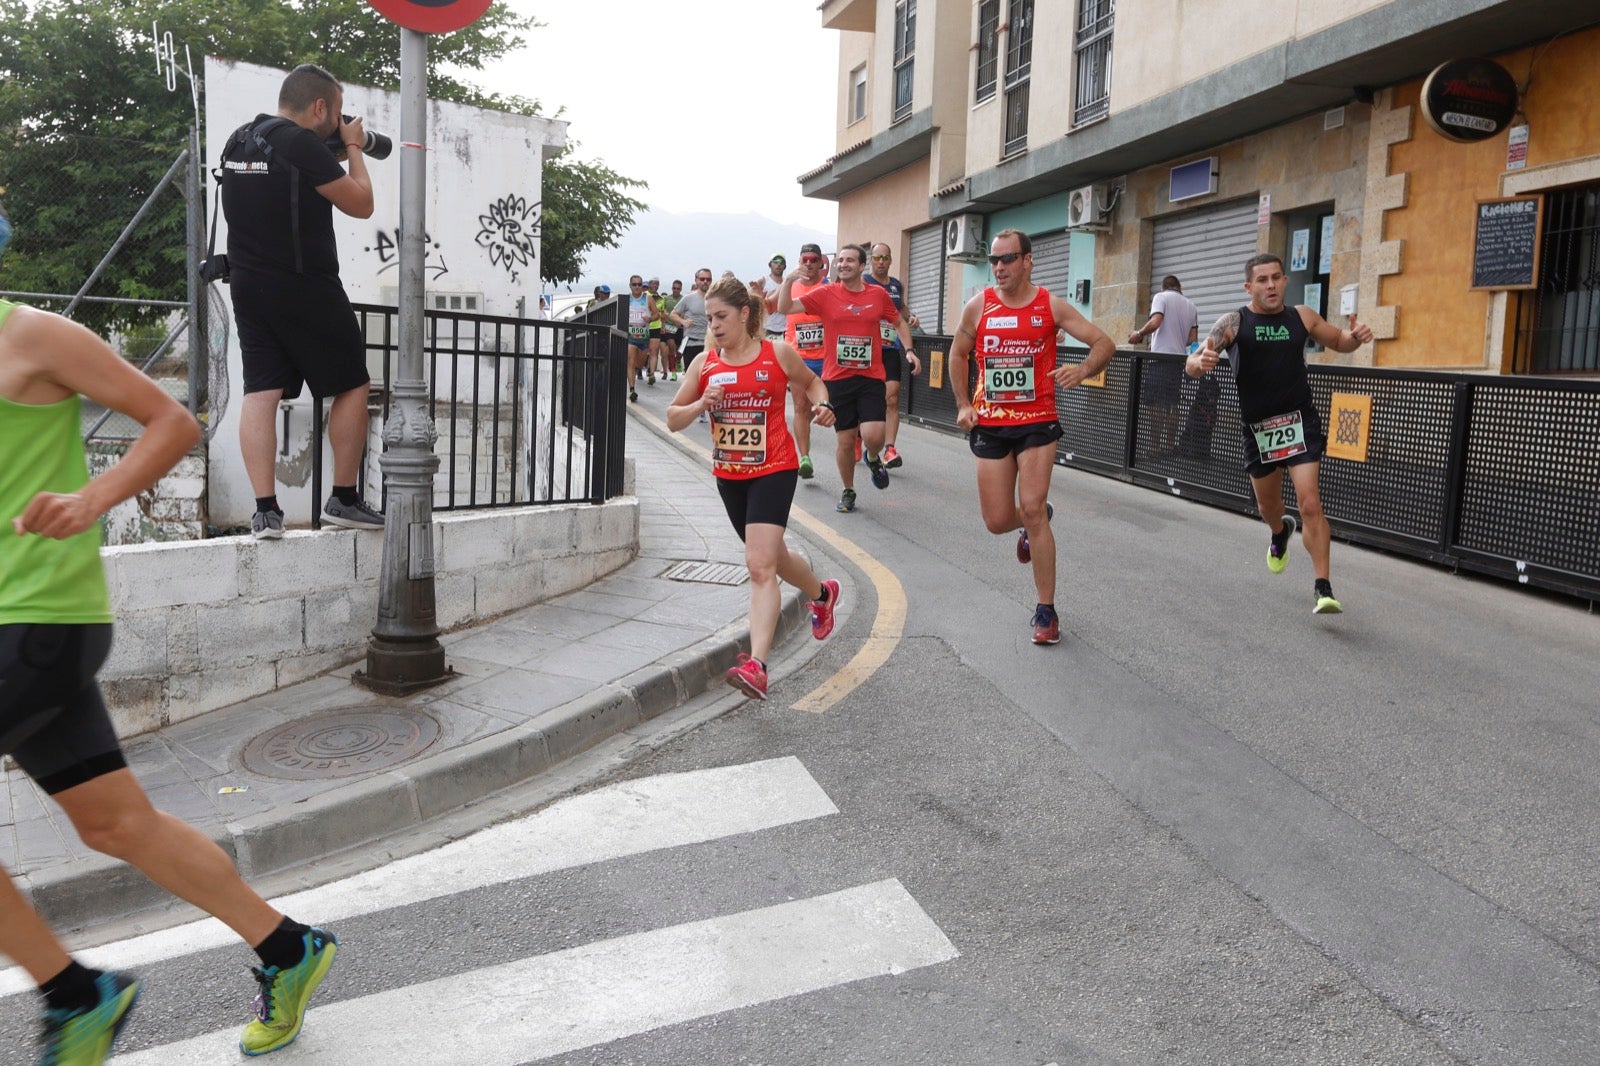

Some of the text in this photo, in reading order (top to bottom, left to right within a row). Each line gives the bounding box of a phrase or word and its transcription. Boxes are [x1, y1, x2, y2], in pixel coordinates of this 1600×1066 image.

[1481, 201, 1534, 218] RACIONES
[800, 330, 822, 340] 3072
[1255, 325, 1290, 335] FILA
[843, 346, 866, 358] 552
[984, 335, 1045, 354] Polisalud
[993, 371, 1026, 387] 609
[711, 396, 772, 411] olisalud
[719, 427, 762, 446] 2129
[1264, 427, 1296, 447] 729
